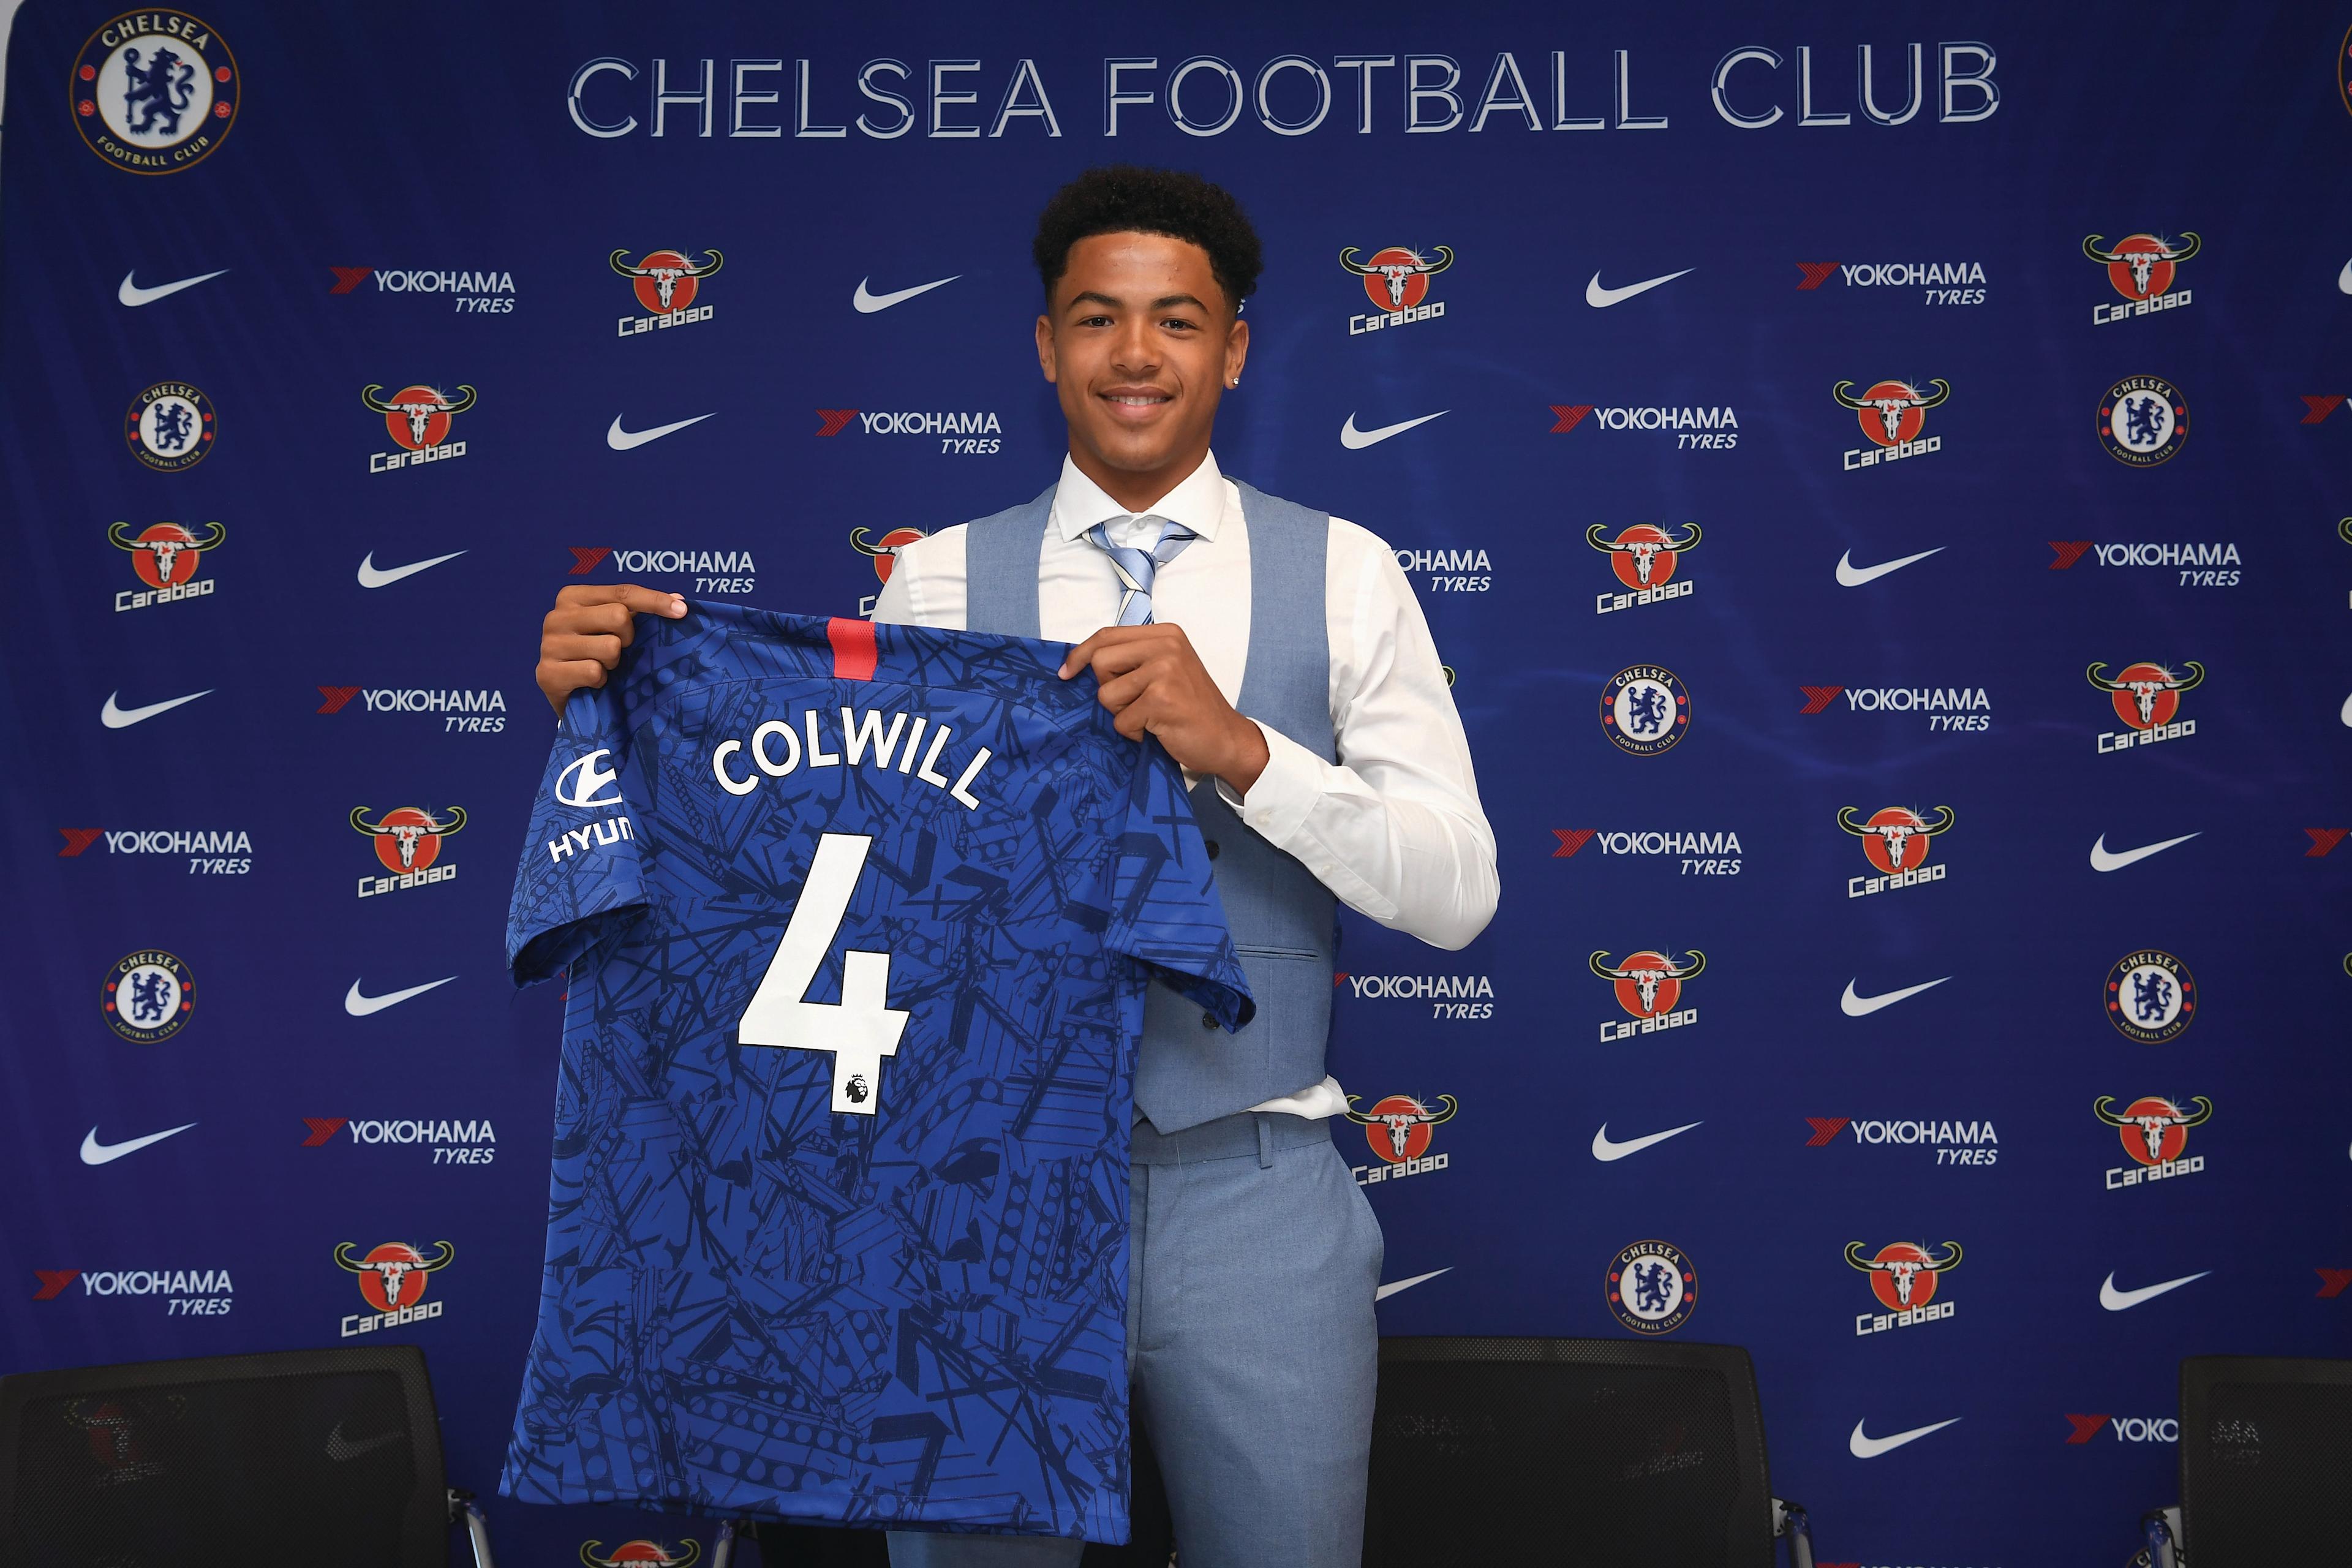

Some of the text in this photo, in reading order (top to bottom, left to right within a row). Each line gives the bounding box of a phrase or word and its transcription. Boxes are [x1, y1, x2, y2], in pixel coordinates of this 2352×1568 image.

[101, 14, 209, 50] CHELSEA
[567, 40, 2001, 140] CHELSEA FOOTBALL CLUB
[97, 135, 209, 166] FOOTBALL CLUB
[374, 270, 516, 293] YOKOHAMA
[1841, 262, 1986, 287] YOKOHAMA
[455, 298, 515, 314] TYRES
[1925, 288, 1986, 306] TYRES
[2093, 290, 2192, 326] Carabao
[618, 304, 713, 337] Carabao
[1349, 301, 1445, 335] Carabao
[142, 385, 202, 404] CHELSEA
[2112, 378, 2171, 398] CHELSEA
[859, 412, 1002, 434] YOKOHAMA
[1594, 407, 1738, 430] YOKOHAMA
[941, 439, 1001, 454] TYRES
[1678, 433, 1738, 450] TYRES
[1844, 435, 1941, 470] Carabao
[140, 450, 201, 468] FOOTBALL CLUB
[370, 441, 466, 473] Carabao
[2112, 445, 2174, 463] FOOTBALL CLUB
[612, 550, 756, 573] YOKOHAMA
[1391, 549, 1491, 571] OHAMA
[2094, 543, 2241, 567] YOKOHAMA
[695, 578, 755, 594] TYRES
[1431, 576, 1491, 592] TYRES
[2179, 570, 2241, 586] TYRES
[115, 579, 214, 612] Carabao
[1597, 579, 1693, 615] Carabao
[1615, 668, 1674, 688] CHELSEA
[362, 689, 507, 712] YOKOHAMA
[1844, 688, 1991, 711] YOKOHAMA
[445, 717, 506, 733] TYRES
[1929, 715, 1991, 731] TYRES
[1615, 734, 1676, 752] FOOTBALL CLUB
[2097, 719, 2196, 754] Carabao
[712, 706, 993, 812] COLWILL
[105, 831, 252, 854] YOKOHAMA
[1596, 832, 1743, 854] YOKOHAMA
[189, 858, 252, 875] TYRES
[1681, 859, 1742, 875] TYRES
[358, 864, 456, 898] Carabao
[1848, 863, 1945, 898] Carabao
[119, 953, 179, 973] CHELSEA
[2119, 952, 2179, 973] CHELSEA
[737, 832, 910, 1116] 4
[1349, 976, 1494, 998] YOKOHAMA
[1433, 1003, 1494, 1019] TYRES
[116, 1022, 178, 1038] FOOTBALL CLUB
[1600, 1008, 1697, 1043] Carabao
[2120, 1022, 2182, 1039] FOOTBALL CLUB
[349, 1120, 496, 1144] YOKOHAMA
[1850, 1120, 1998, 1144] YOKOHAMA
[433, 1148, 496, 1164] TYRES
[1937, 1148, 1998, 1166] TYRES
[1351, 1153, 1449, 1186] Carabao
[2106, 1156, 2204, 1190] Carabao
[1621, 1243, 1680, 1265] CHELSEA
[81, 1270, 233, 1296] YOKOHAMA
[168, 1298, 232, 1316] TYRES
[341, 1302, 442, 1338] Carabao
[1621, 1312, 1683, 1330] FOOTBALL CLUB
[1856, 1301, 1954, 1336] Carabao
